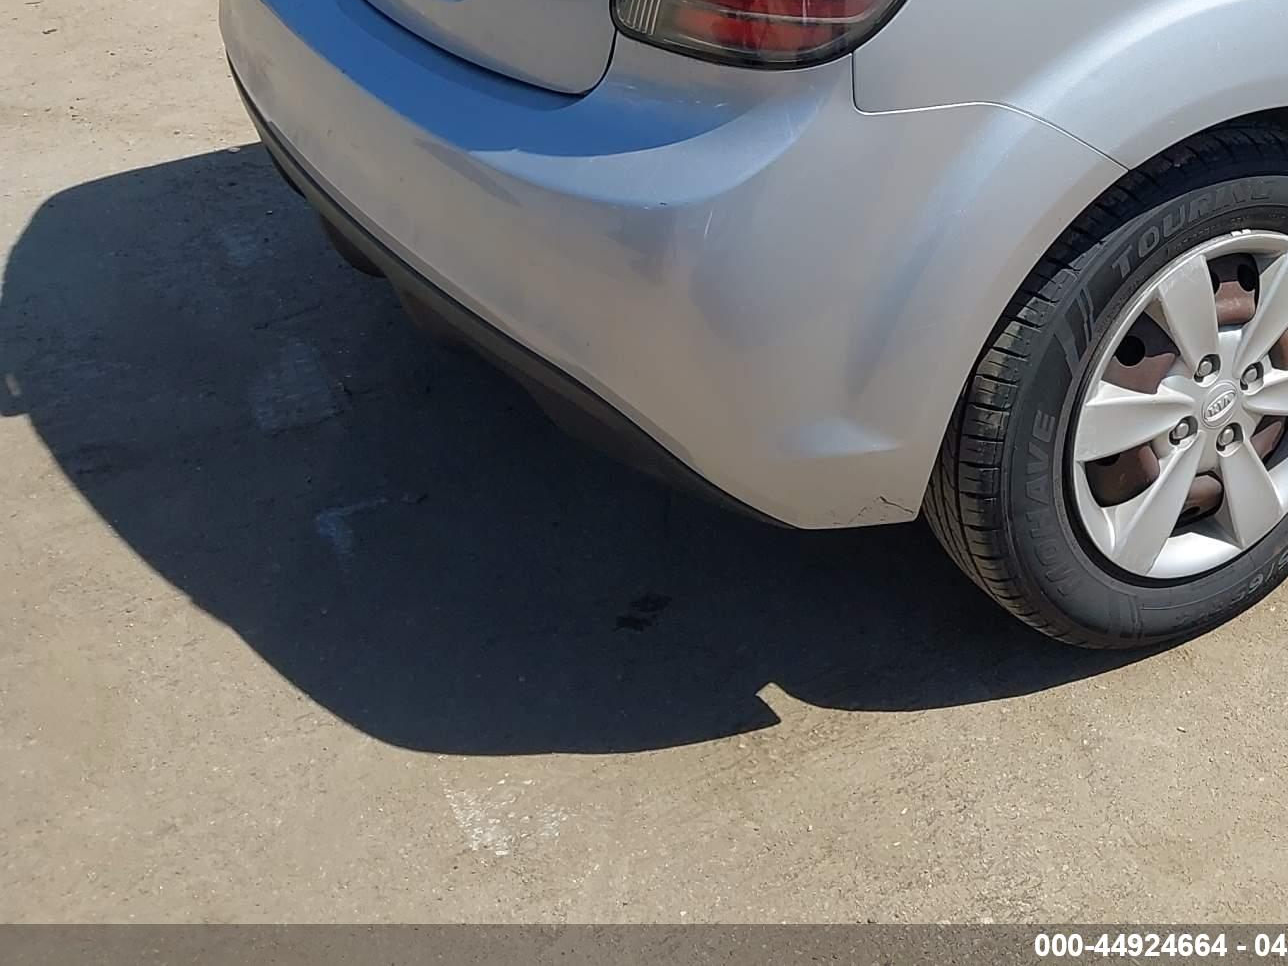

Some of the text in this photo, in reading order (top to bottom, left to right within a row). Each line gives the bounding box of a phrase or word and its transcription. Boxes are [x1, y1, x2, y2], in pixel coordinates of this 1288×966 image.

[1111, 180, 1275, 279] TOURING
[1205, 393, 1233, 418] KIA
[1024, 408, 1079, 598] MOHAVE
